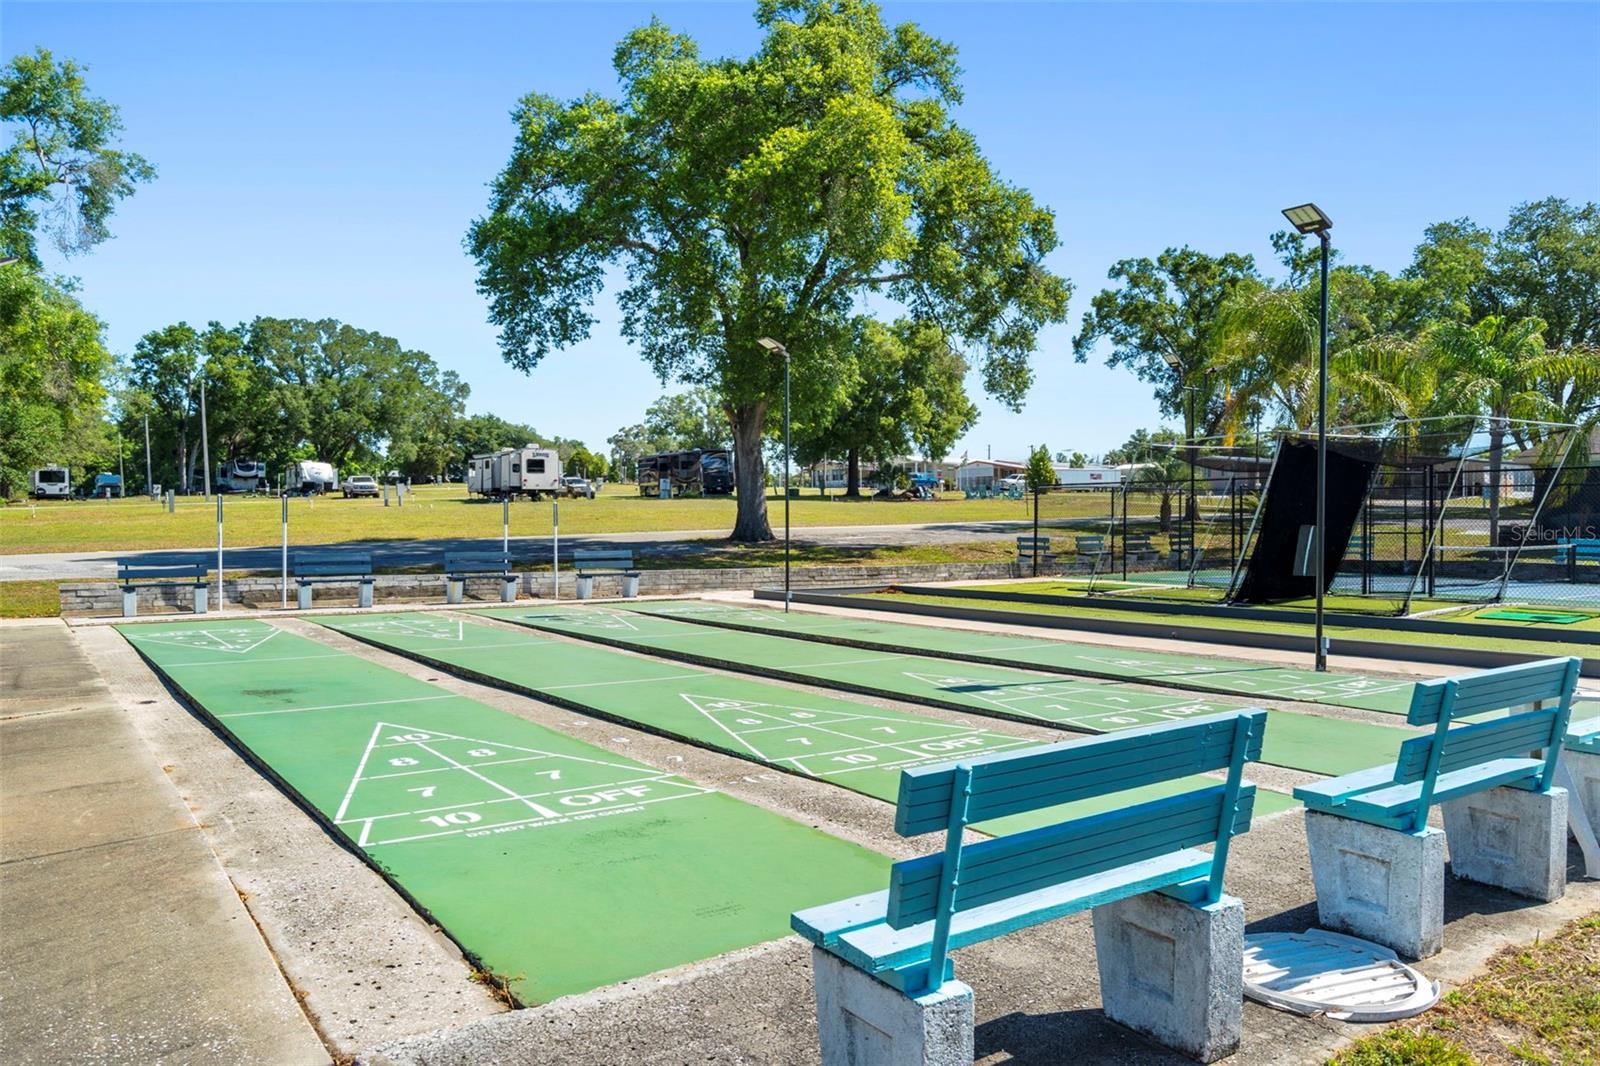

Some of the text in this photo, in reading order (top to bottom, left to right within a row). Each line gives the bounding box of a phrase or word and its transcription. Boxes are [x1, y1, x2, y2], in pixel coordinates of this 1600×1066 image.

[871, 726, 897, 734] 7
[385, 733, 431, 742] 10
[785, 737, 813, 746] 7
[466, 748, 498, 757] 8
[831, 753, 879, 765] 10
[919, 736, 985, 751] OFF
[388, 757, 420, 767] 8
[535, 769, 562, 780] 7
[407, 785, 437, 798] 7
[419, 784, 652, 828] 10 OFF
[465, 830, 491, 838] DO
[493, 824, 525, 834] NOT
